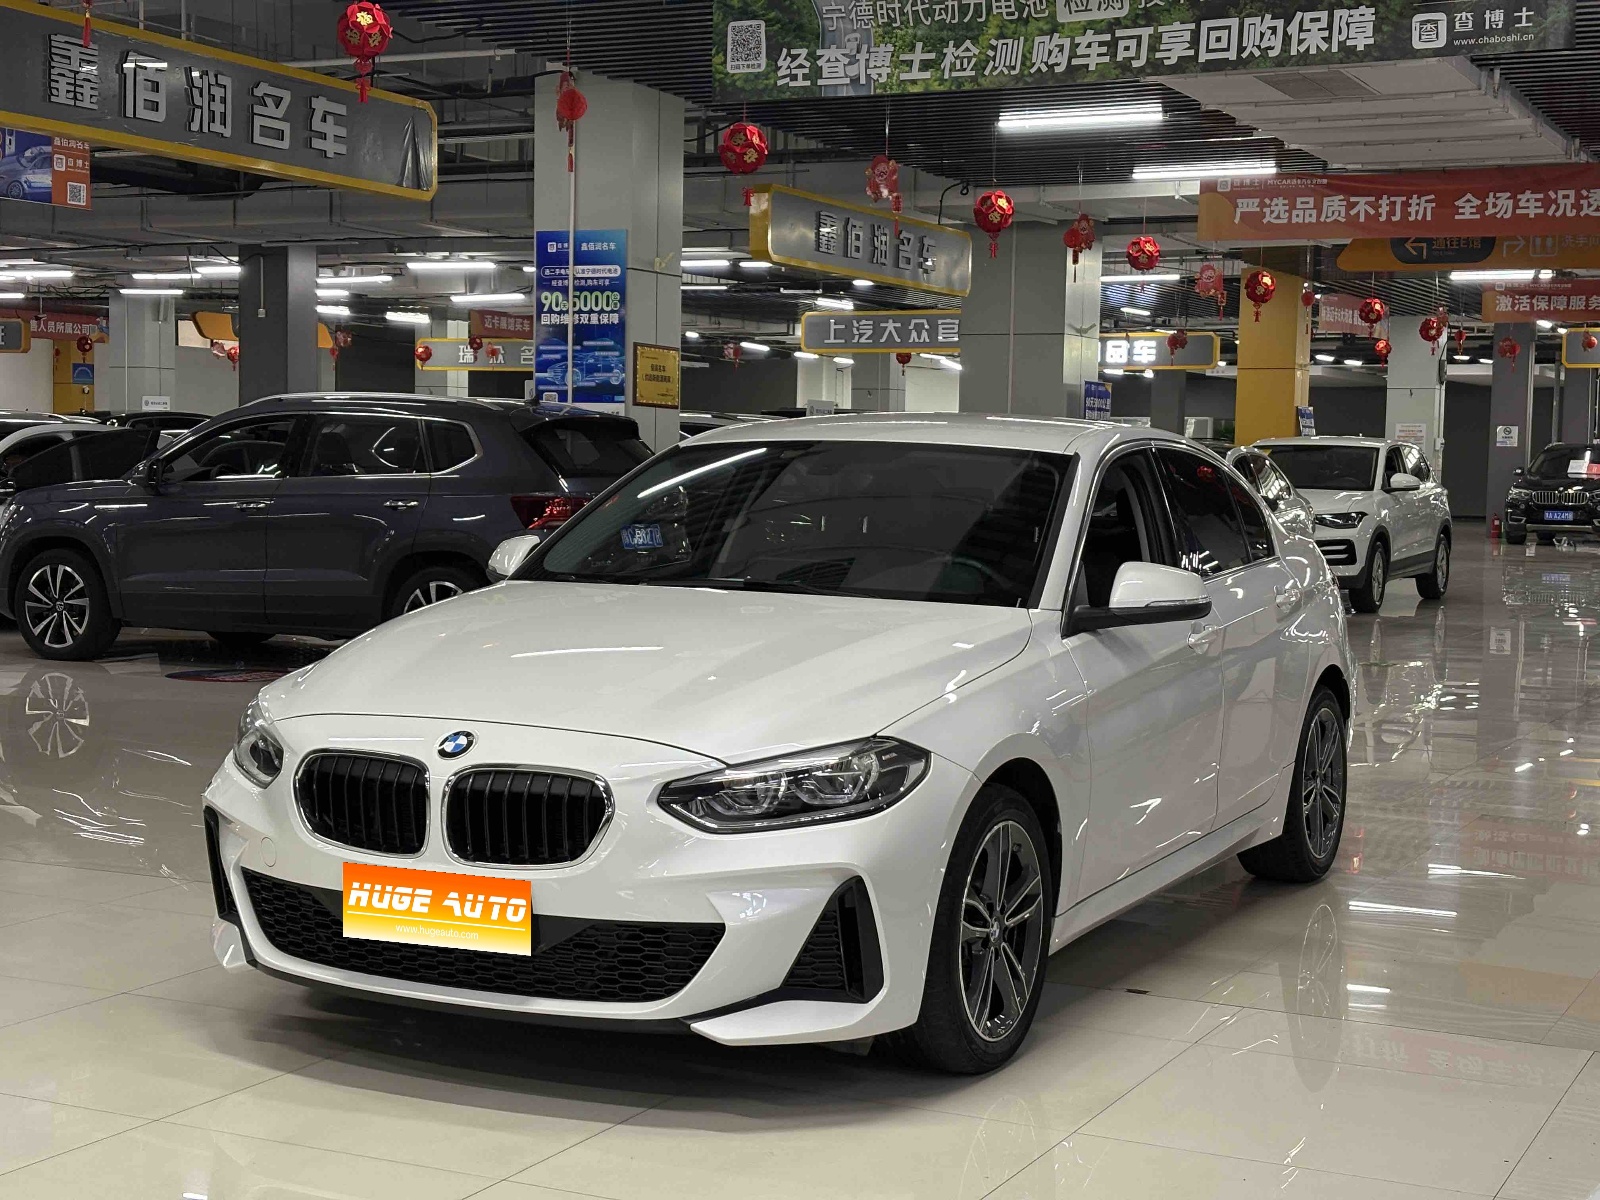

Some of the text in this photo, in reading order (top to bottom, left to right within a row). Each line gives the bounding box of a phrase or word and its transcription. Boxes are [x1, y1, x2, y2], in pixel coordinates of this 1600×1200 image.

[1453, 7, 1535, 32] 查博士
[777, 6, 1376, 86] 经查博士检测购车可享回购保障
[1453, 33, 1534, 46] www.chaboshi.cn
[49, 34, 347, 158] 鑫佰润名车
[1234, 194, 1436, 225] 严选品质不打折
[816, 210, 936, 274] 鑫佰润名车
[824, 319, 960, 343] 上汽大众官
[1098, 340, 1157, 364] 品车
